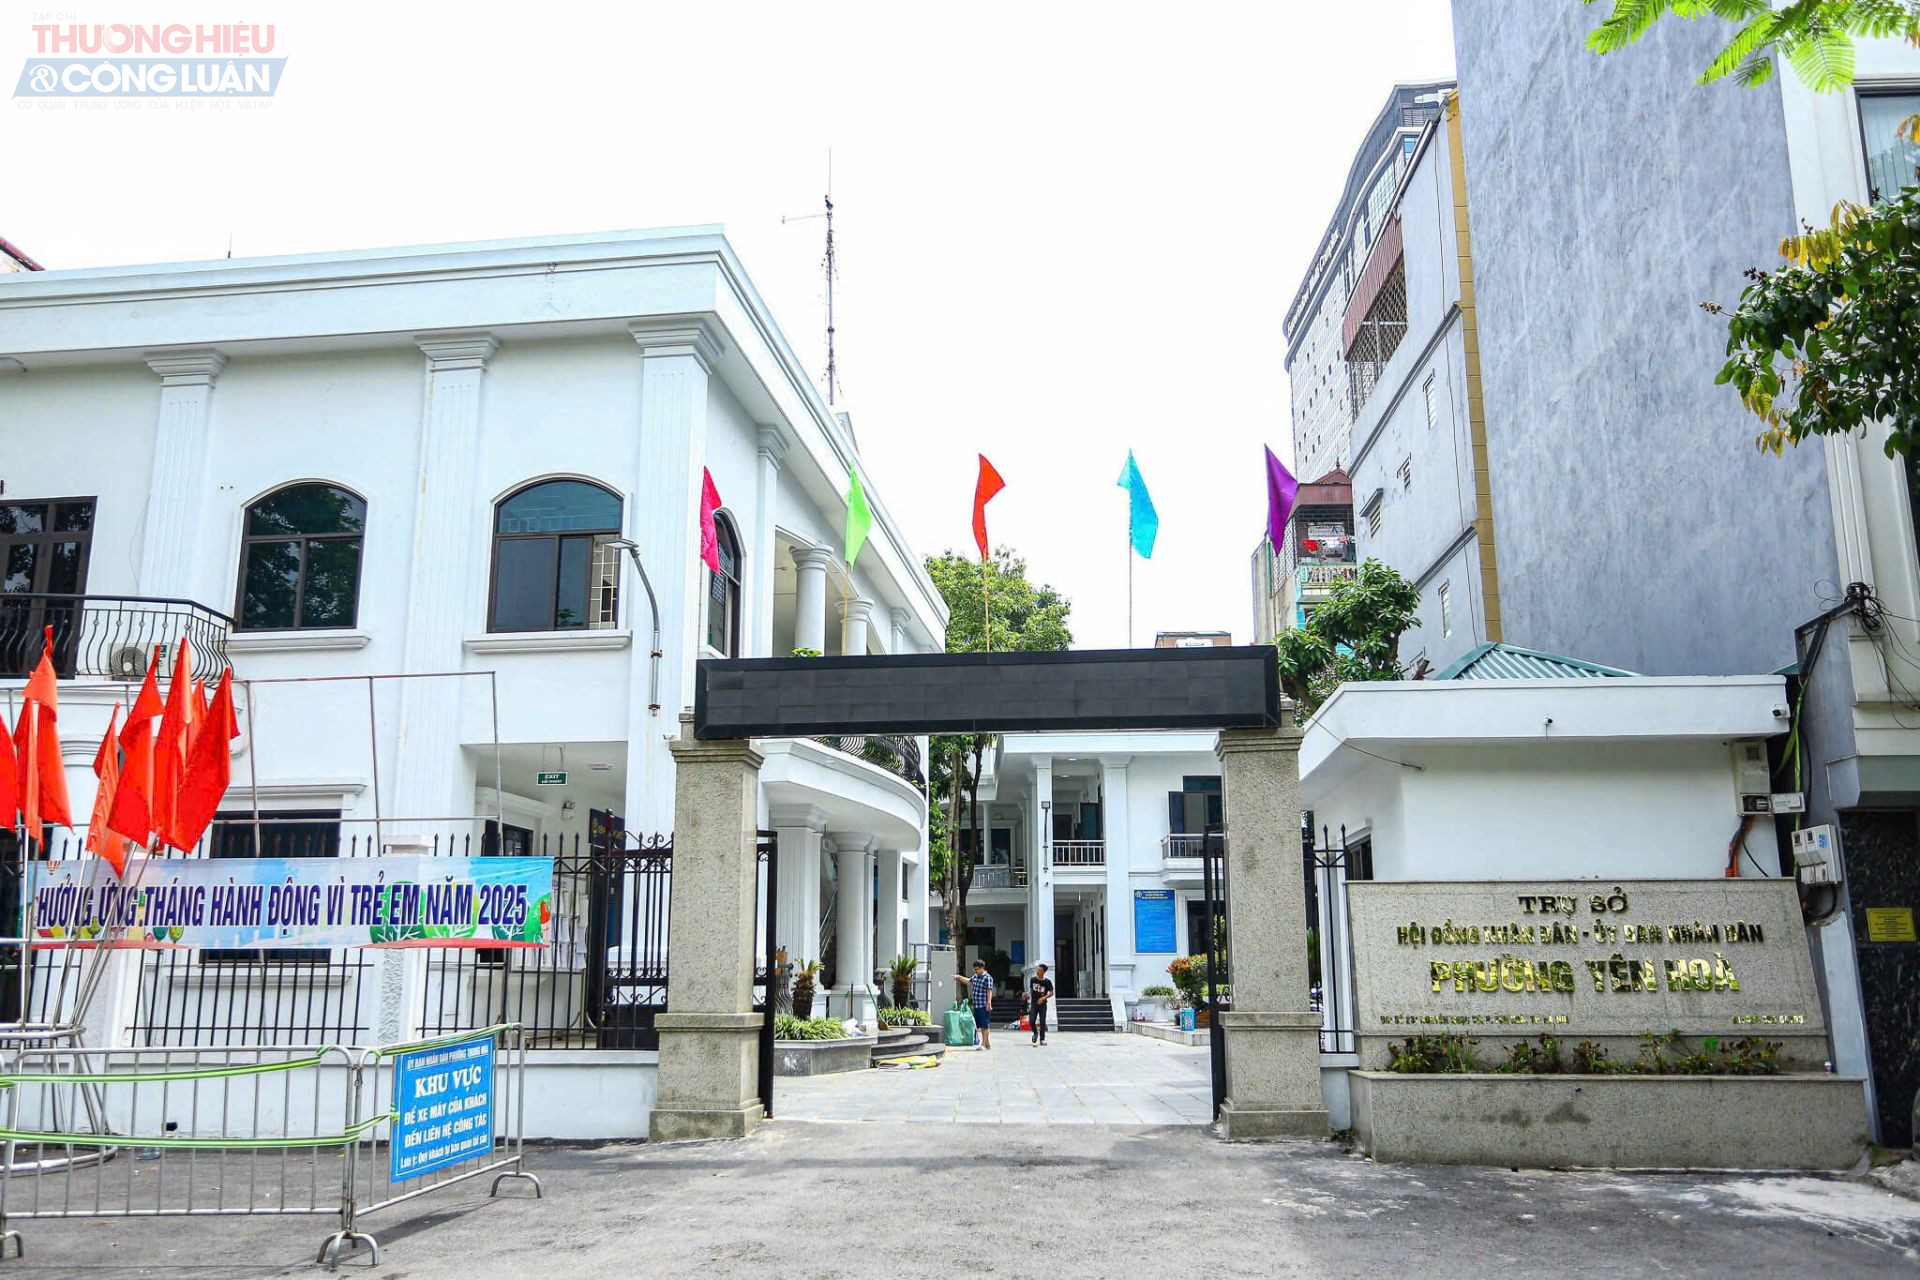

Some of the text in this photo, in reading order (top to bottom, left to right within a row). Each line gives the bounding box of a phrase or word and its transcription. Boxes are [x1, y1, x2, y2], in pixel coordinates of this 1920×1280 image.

[36, 870, 528, 936] HƯỞNG ỨNG THÁNG HÀNH ĐỘNG VÌ TRẺ EM NĂM 2025
[1518, 886, 1629, 918] TRỤ SỞ
[1397, 921, 1427, 949] HỘI
[1484, 921, 1536, 945] NHÂN
[1623, 924, 1663, 944] BAN
[1666, 920, 1720, 944] NHÂN
[1724, 919, 1765, 944] DÂN
[1430, 951, 1741, 993] PHƯỜNG YÊN HOÀ
[414, 1064, 482, 1099] KHU VỰC
[418, 1107, 428, 1122] XE
[430, 1102, 447, 1119] MÁY
[448, 1096, 463, 1114] CỦA
[464, 1092, 487, 1110] KHÁCH
[423, 1125, 441, 1143] LIÊN
[442, 1121, 453, 1139] HỆ
[453, 1117, 474, 1134] CÔNG
[475, 1112, 487, 1128] TÁC
